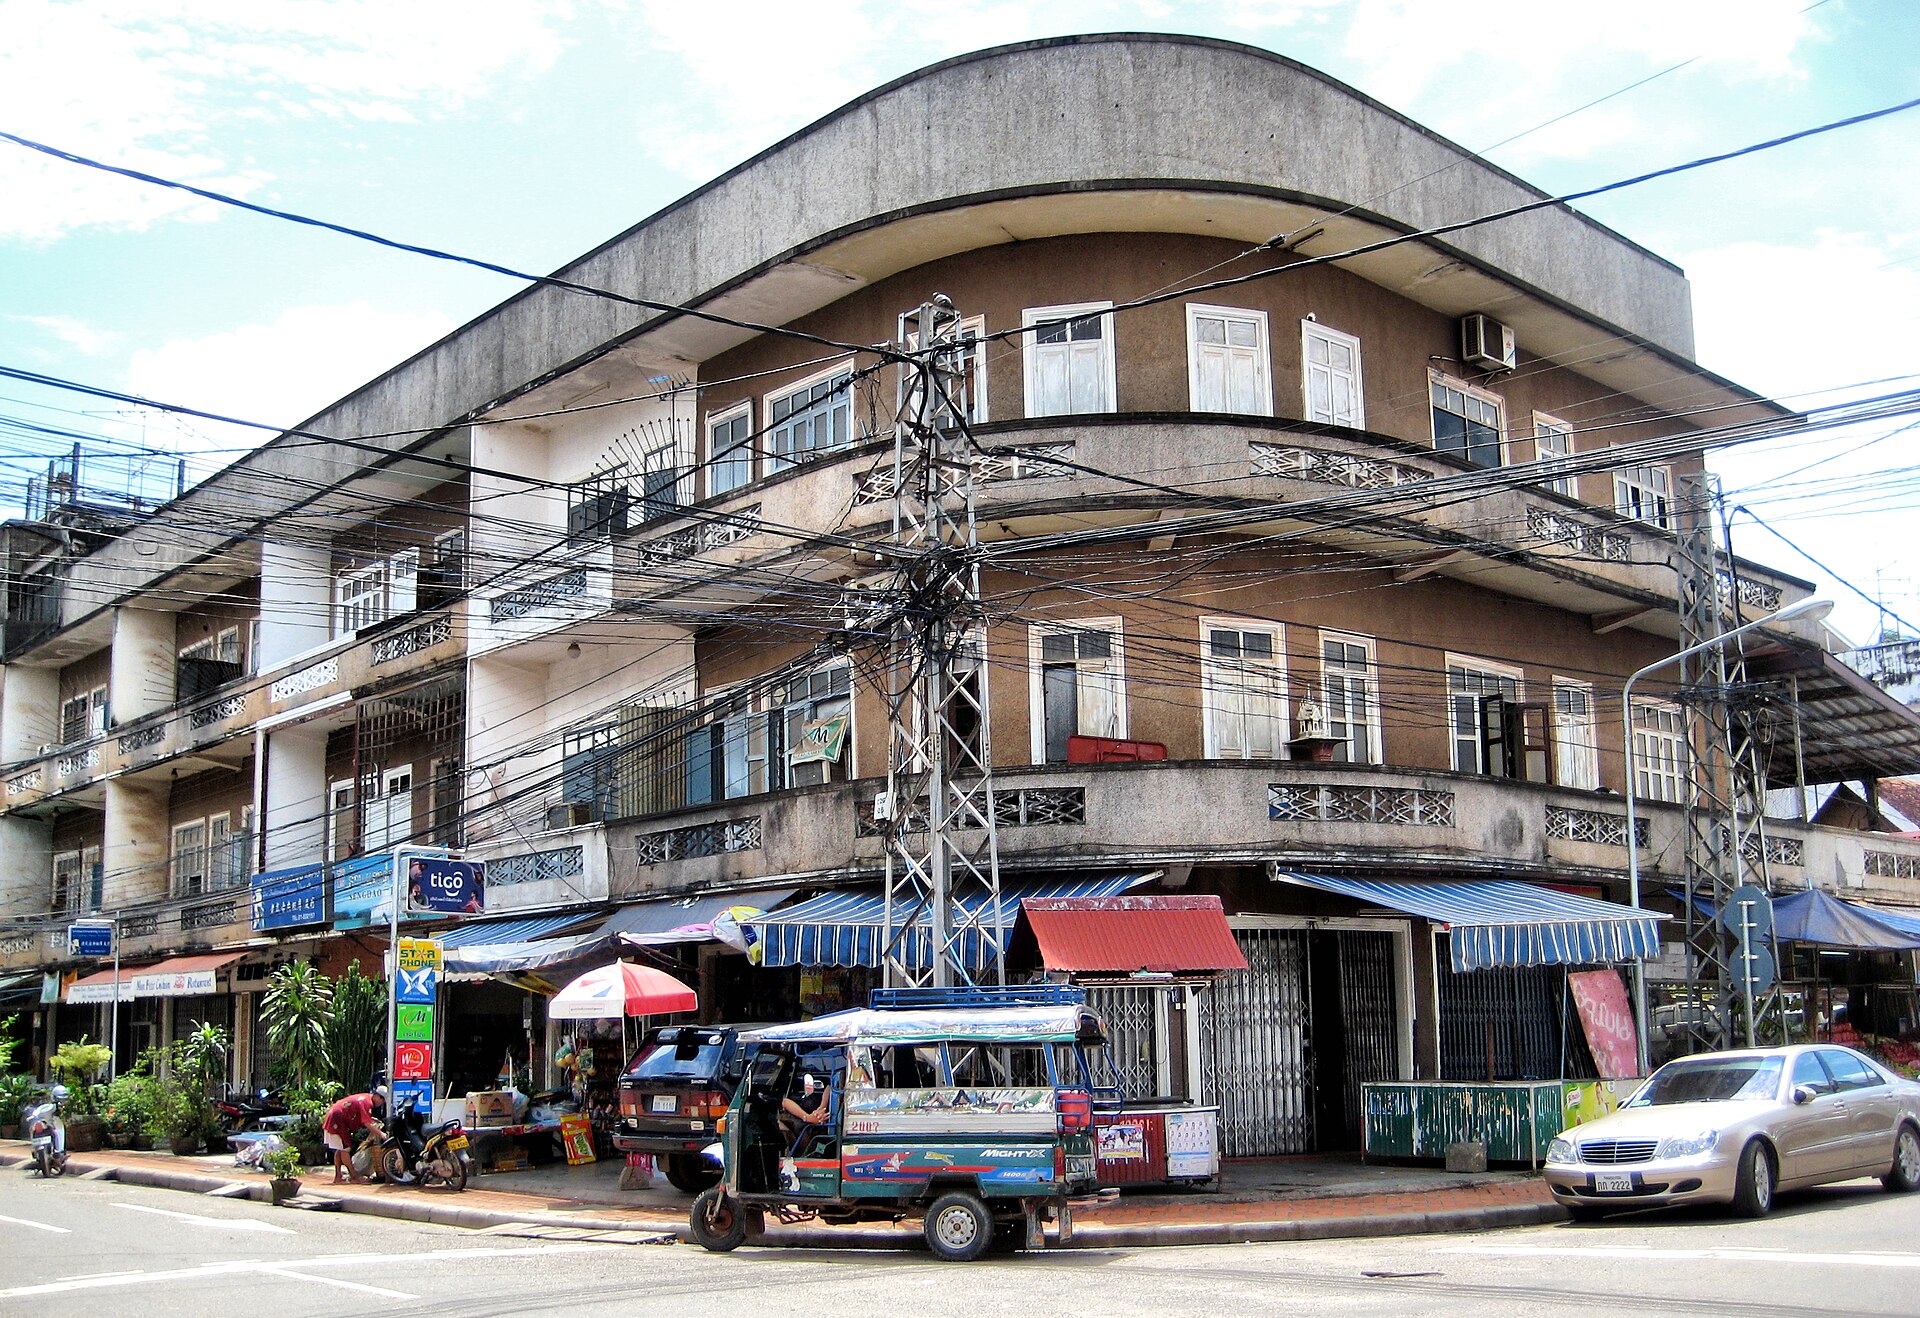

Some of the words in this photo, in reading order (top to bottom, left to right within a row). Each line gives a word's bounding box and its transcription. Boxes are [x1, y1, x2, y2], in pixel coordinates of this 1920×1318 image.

[430, 871, 464, 890] tigo
[400, 959, 434, 967] PHONE
[851, 1121, 879, 1133] 2007
[1610, 1180, 1630, 1190] 2222
